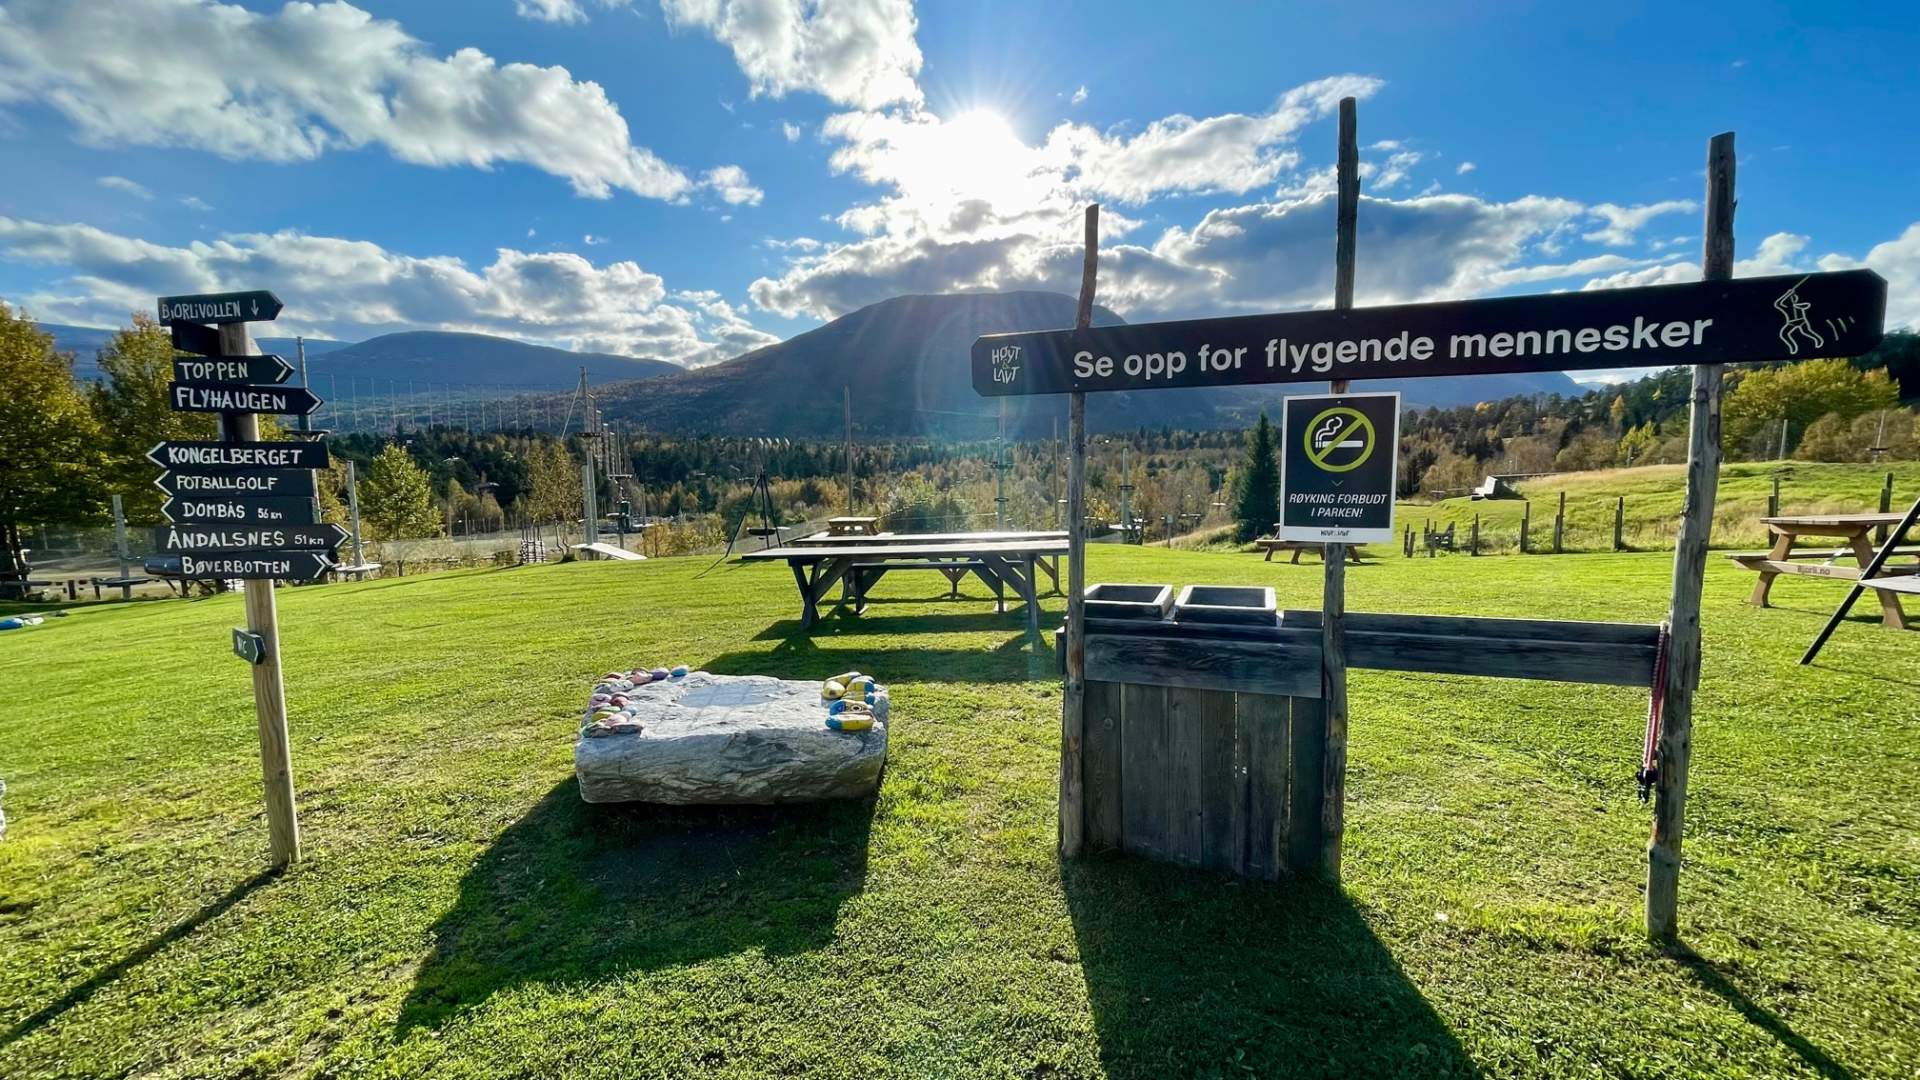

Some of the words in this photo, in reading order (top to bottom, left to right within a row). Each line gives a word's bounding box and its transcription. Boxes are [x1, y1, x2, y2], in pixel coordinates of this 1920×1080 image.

[1073, 350, 1114, 379] Se
[1123, 350, 1187, 380] opp
[1198, 343, 1248, 373] for
[1265, 330, 1435, 374] flygende
[1449, 315, 1714, 359] mennesker
[178, 362, 249, 380] TOPPEN
[176, 387, 286, 410] FLYHAUGEN
[168, 447, 303, 465] KONGELBERGET
[176, 475, 278, 490] FOTBALLGOLF
[1289, 493, 1336, 504] RØYKING
[1337, 493, 1388, 505] FORBUDT
[182, 501, 245, 519] DOMBÅS
[258, 507, 269, 519] 56
[1311, 507, 1316, 517] I
[1317, 507, 1364, 518] PARKEN!
[167, 525, 285, 549] ÅNDALSNES
[294, 535, 308, 545] 51
